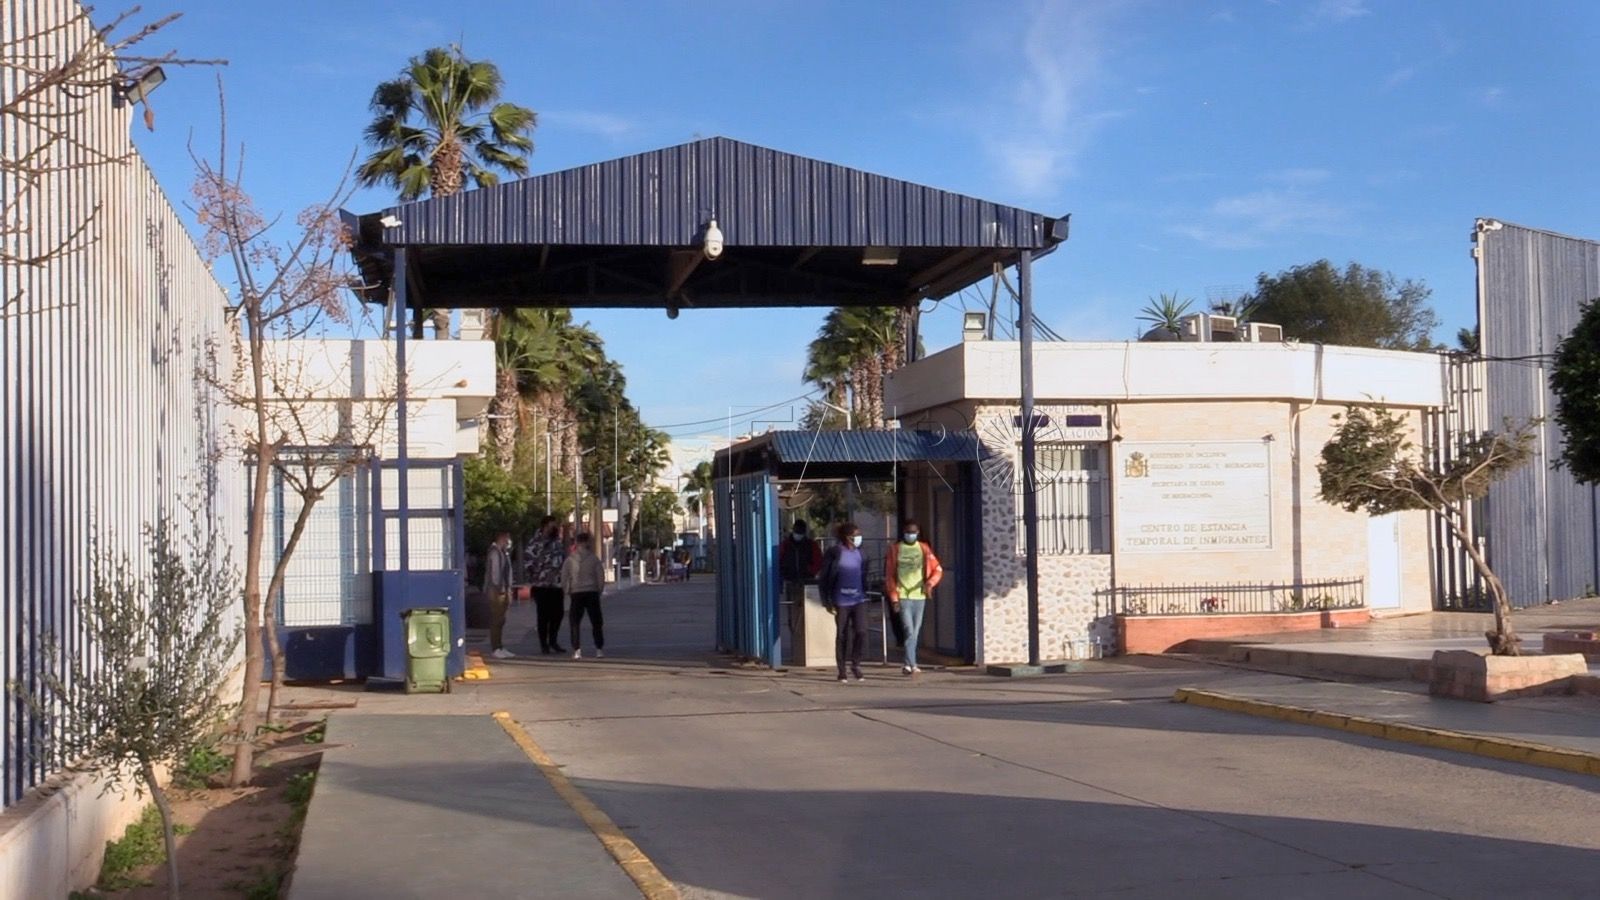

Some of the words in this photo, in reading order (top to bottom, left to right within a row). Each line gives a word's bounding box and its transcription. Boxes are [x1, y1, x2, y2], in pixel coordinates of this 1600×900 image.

[1140, 523, 1180, 533] CENTRO
[1184, 523, 1198, 532] DE
[1200, 523, 1247, 532] ESTANCIA
[1126, 537, 1181, 546] TEMPORAL
[1184, 536, 1198, 545] DE
[1200, 535, 1267, 545] INMIGRANTES
